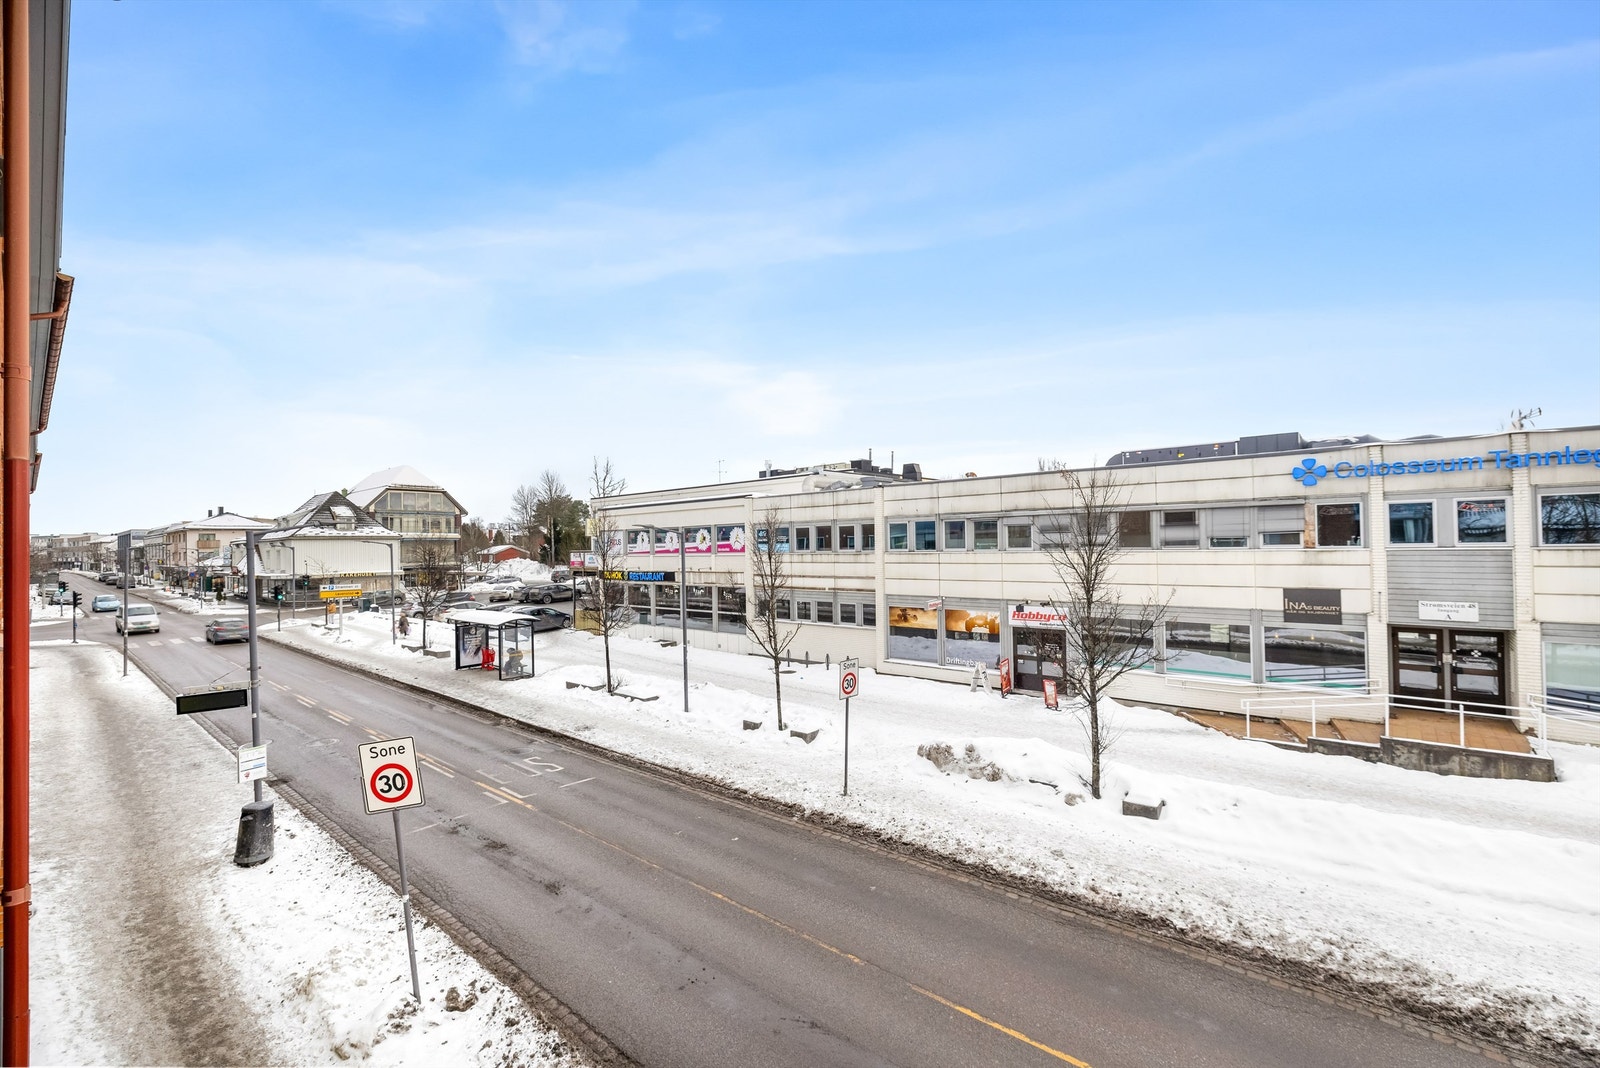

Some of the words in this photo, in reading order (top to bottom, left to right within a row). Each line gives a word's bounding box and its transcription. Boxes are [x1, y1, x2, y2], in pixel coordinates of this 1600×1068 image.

[1334, 455, 1483, 479] Colosseum
[628, 571, 665, 581] RESTAURANT
[843, 662, 856, 670] Sone
[844, 677, 854, 690] 30
[369, 745, 406, 759] Sone
[378, 772, 406, 794] 30
